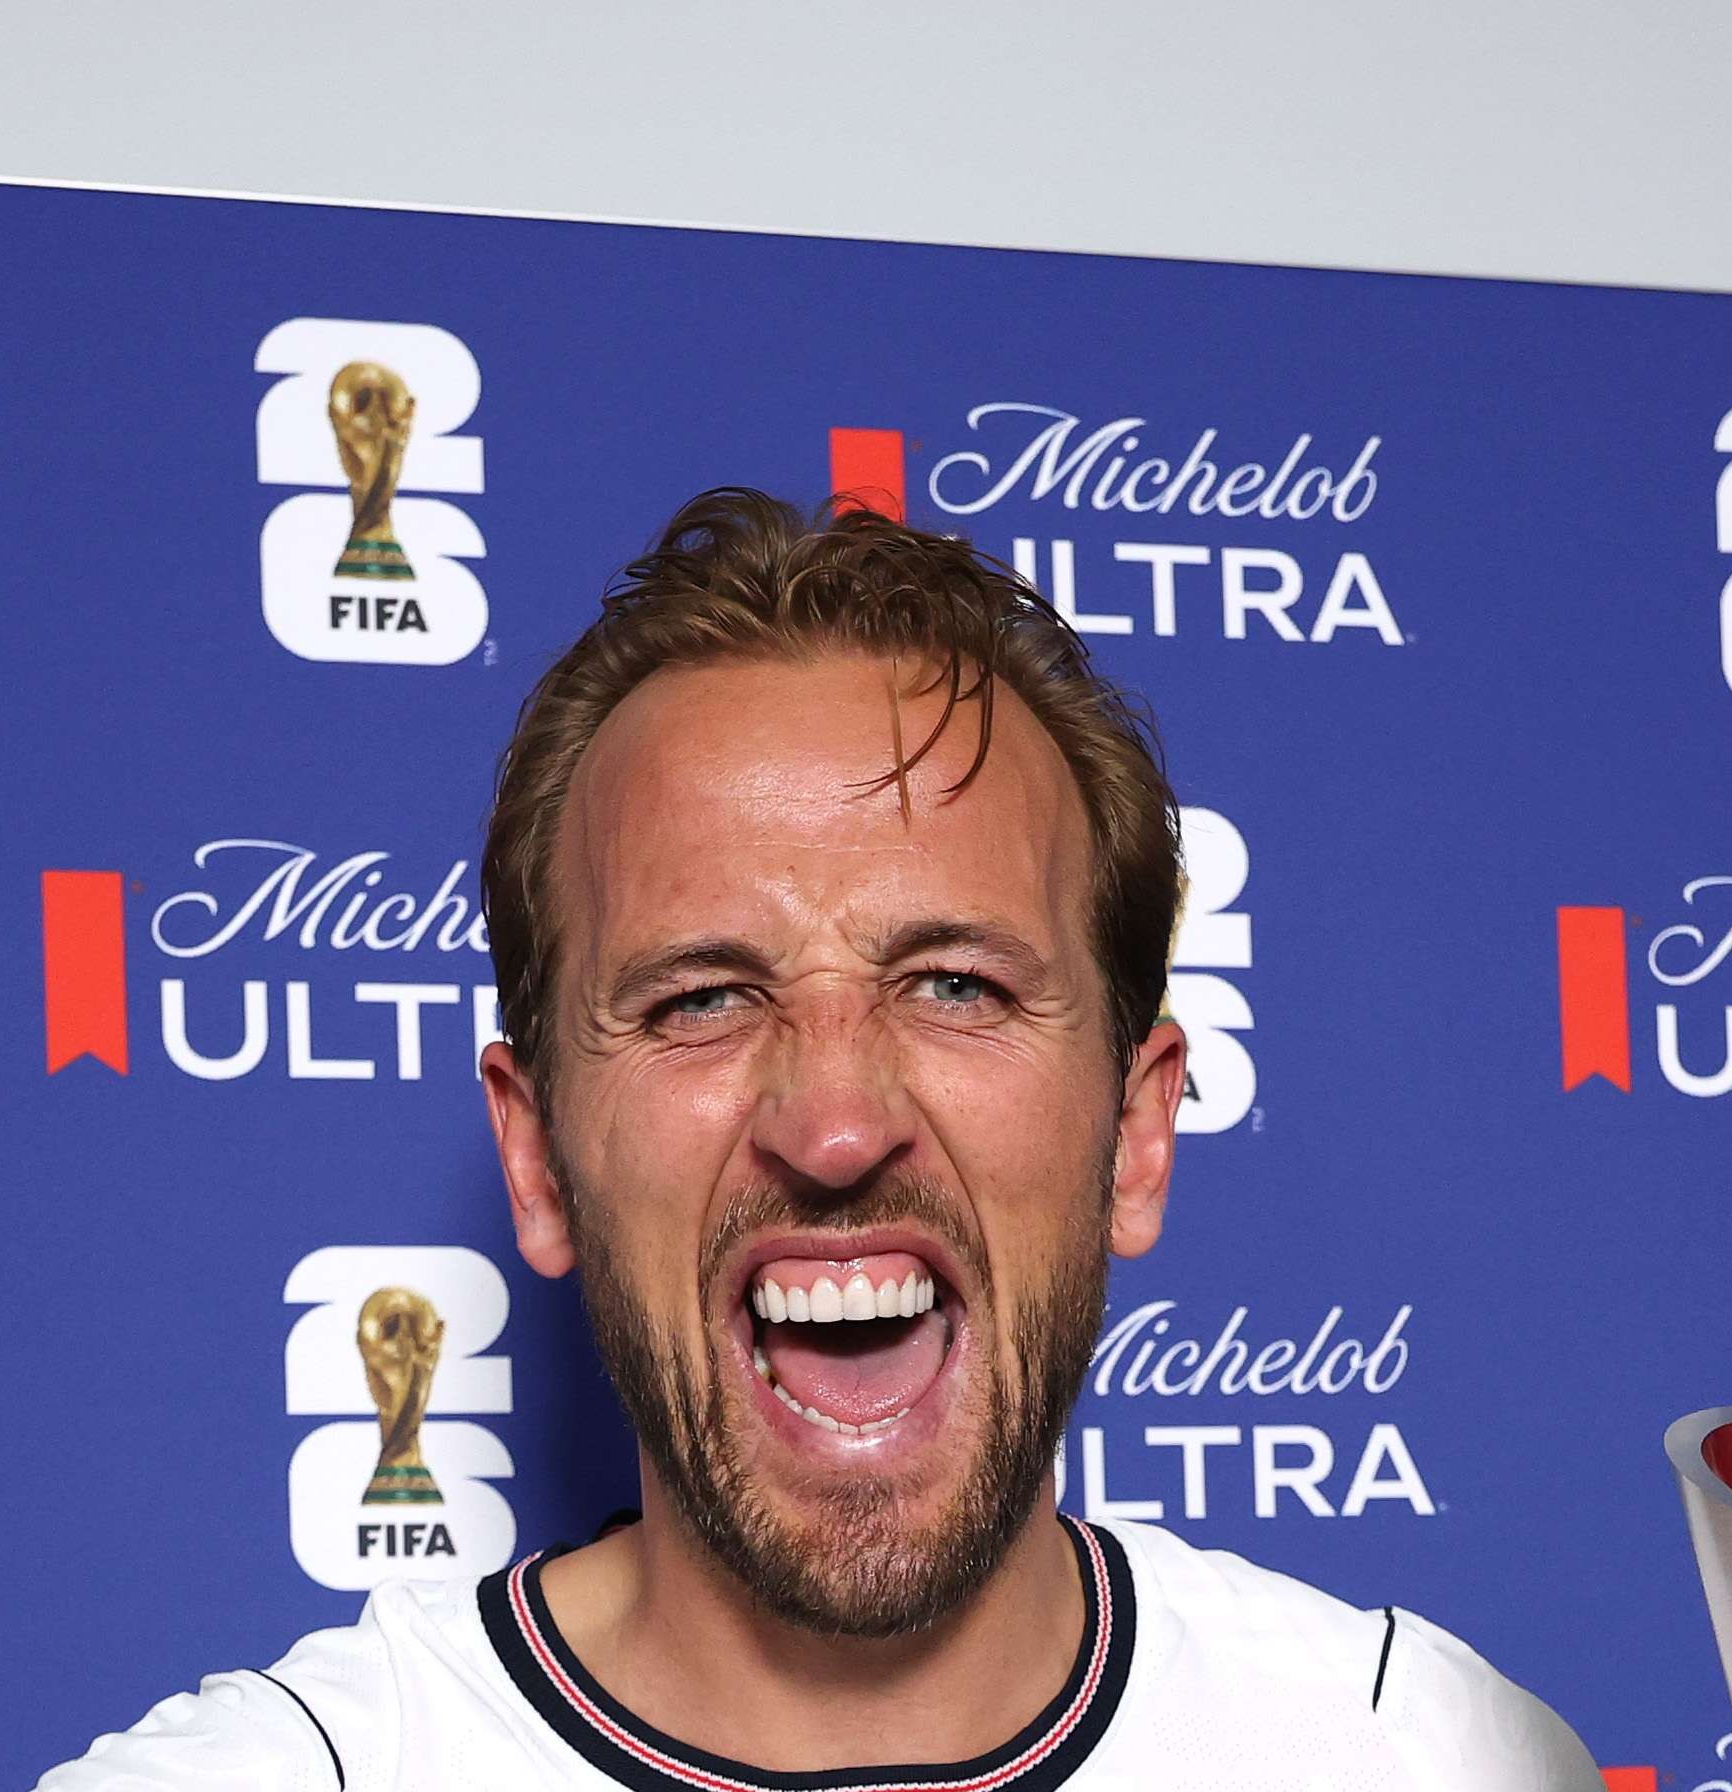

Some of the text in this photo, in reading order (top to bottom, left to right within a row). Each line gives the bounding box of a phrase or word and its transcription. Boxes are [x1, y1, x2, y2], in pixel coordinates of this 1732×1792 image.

[928, 403, 1381, 522] Michelob
[330, 596, 428, 633] FIFA
[1054, 1423, 1436, 1521] LTRA
[358, 1523, 457, 1558] FIFA
